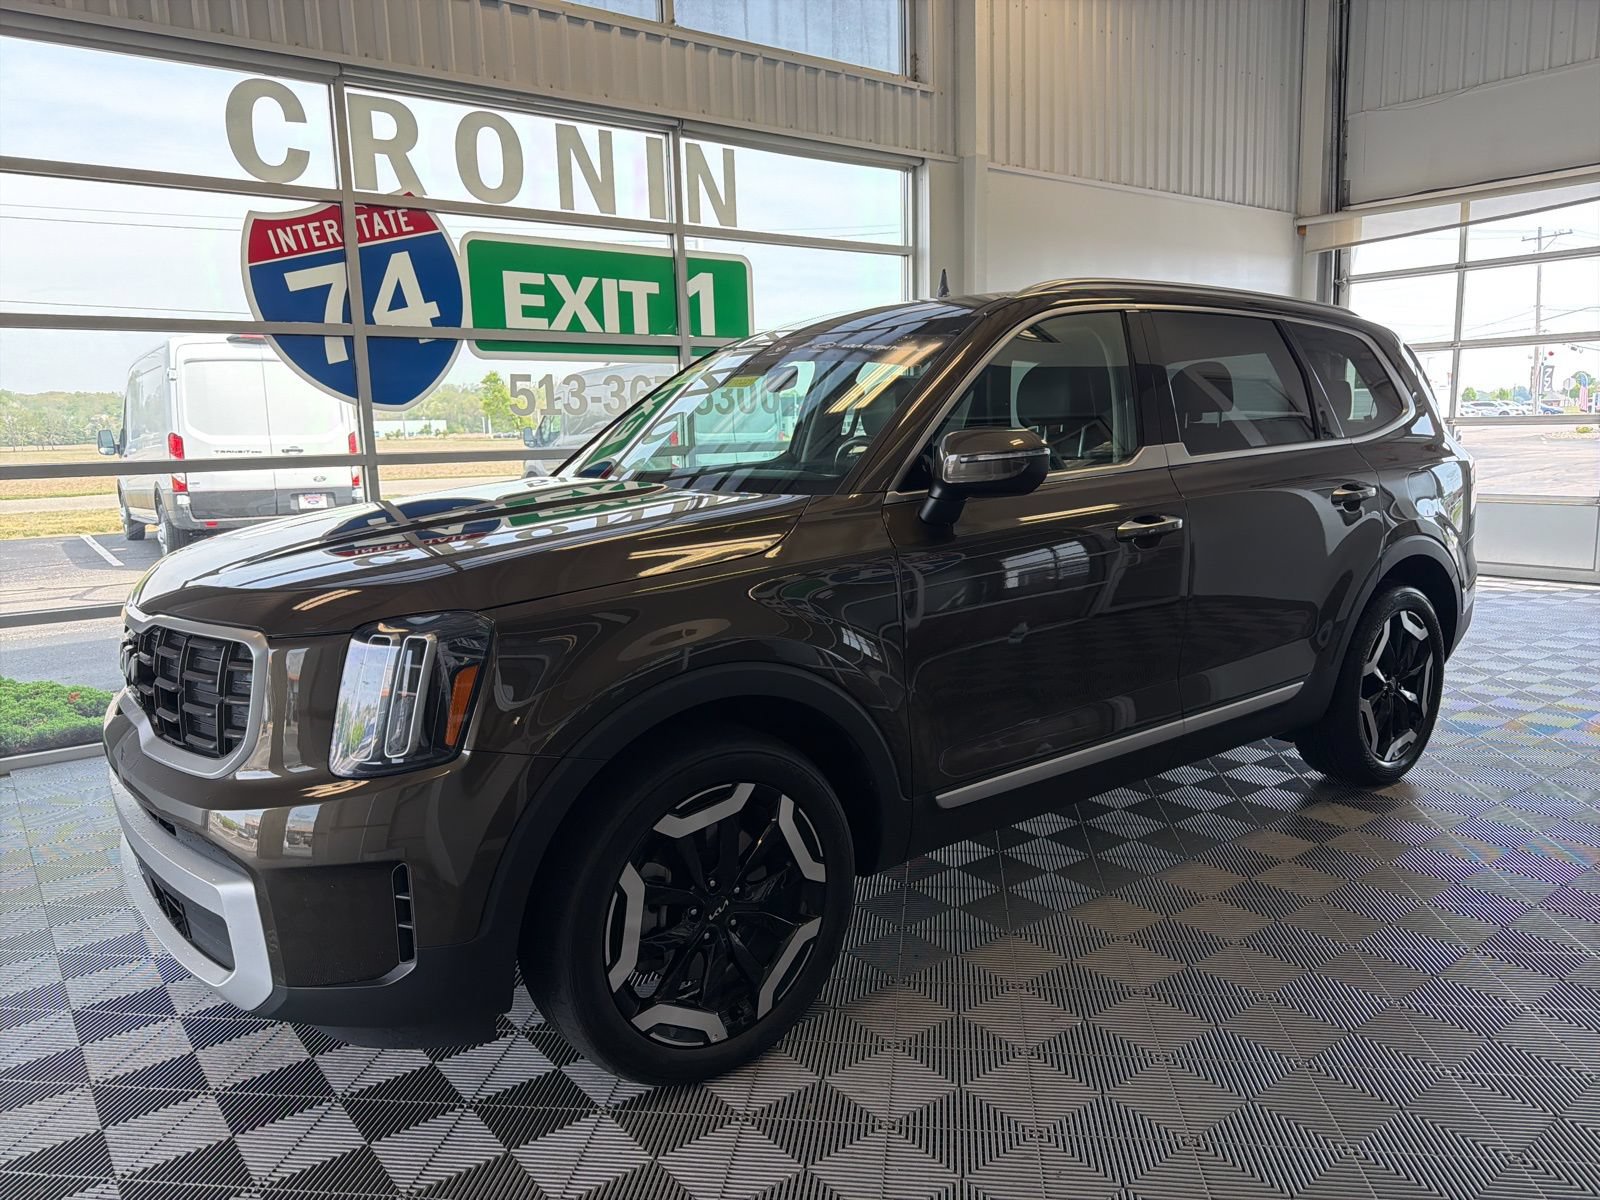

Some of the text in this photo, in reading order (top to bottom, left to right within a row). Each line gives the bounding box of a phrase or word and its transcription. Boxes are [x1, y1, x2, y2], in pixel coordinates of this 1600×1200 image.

[225, 78, 737, 228] CRONIN
[267, 208, 414, 254] INTERTATE
[283, 250, 441, 365] 74
[502, 270, 716, 337] EXIT 1
